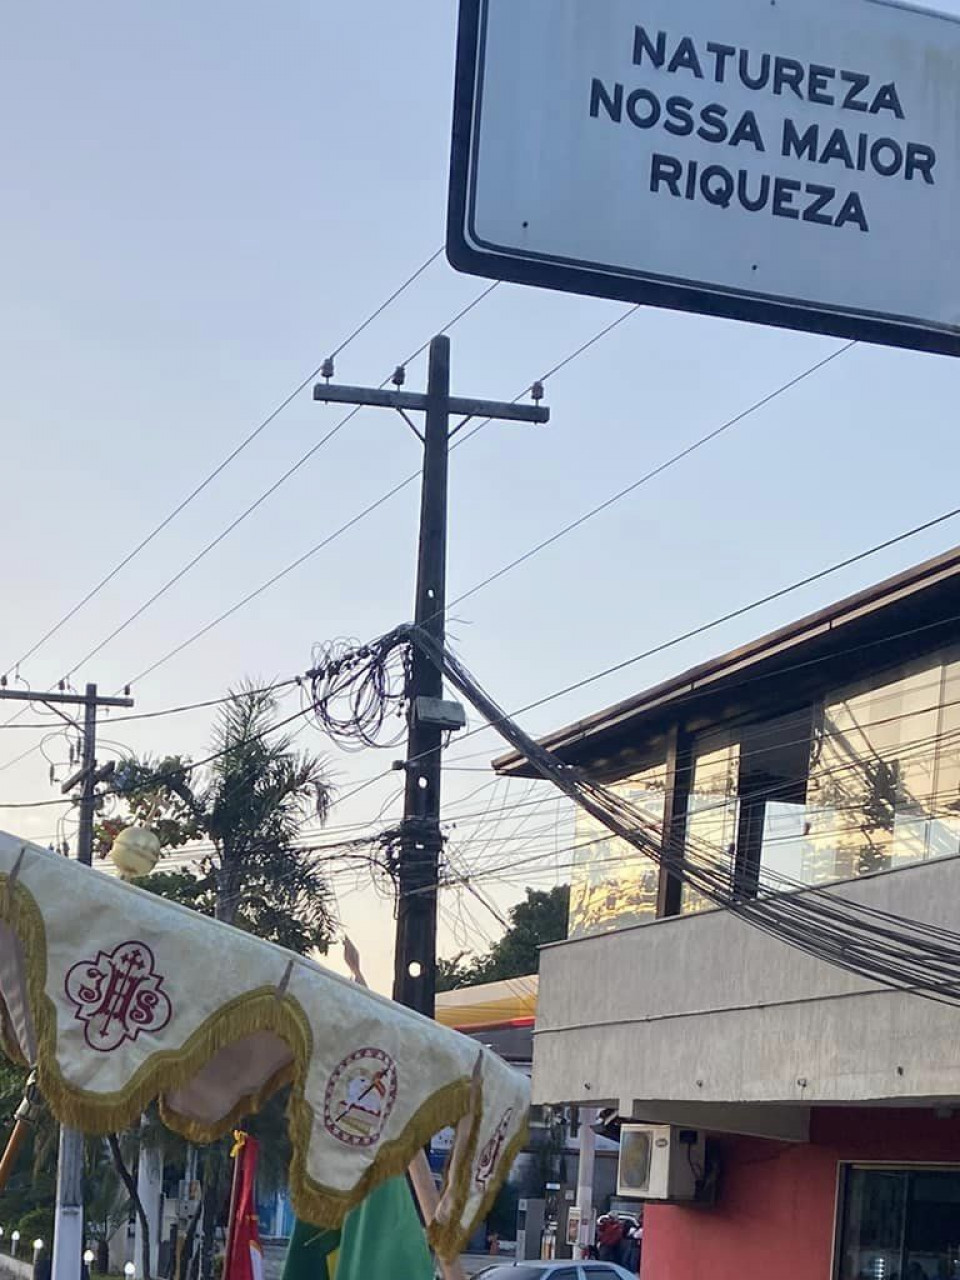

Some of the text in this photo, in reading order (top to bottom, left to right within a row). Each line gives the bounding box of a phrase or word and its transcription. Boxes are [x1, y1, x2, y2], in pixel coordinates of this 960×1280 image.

[632, 24, 905, 120] NATUREZA
[589, 77, 937, 185] NOSSA MAIOR
[649, 152, 870, 233] RIQUEZA
